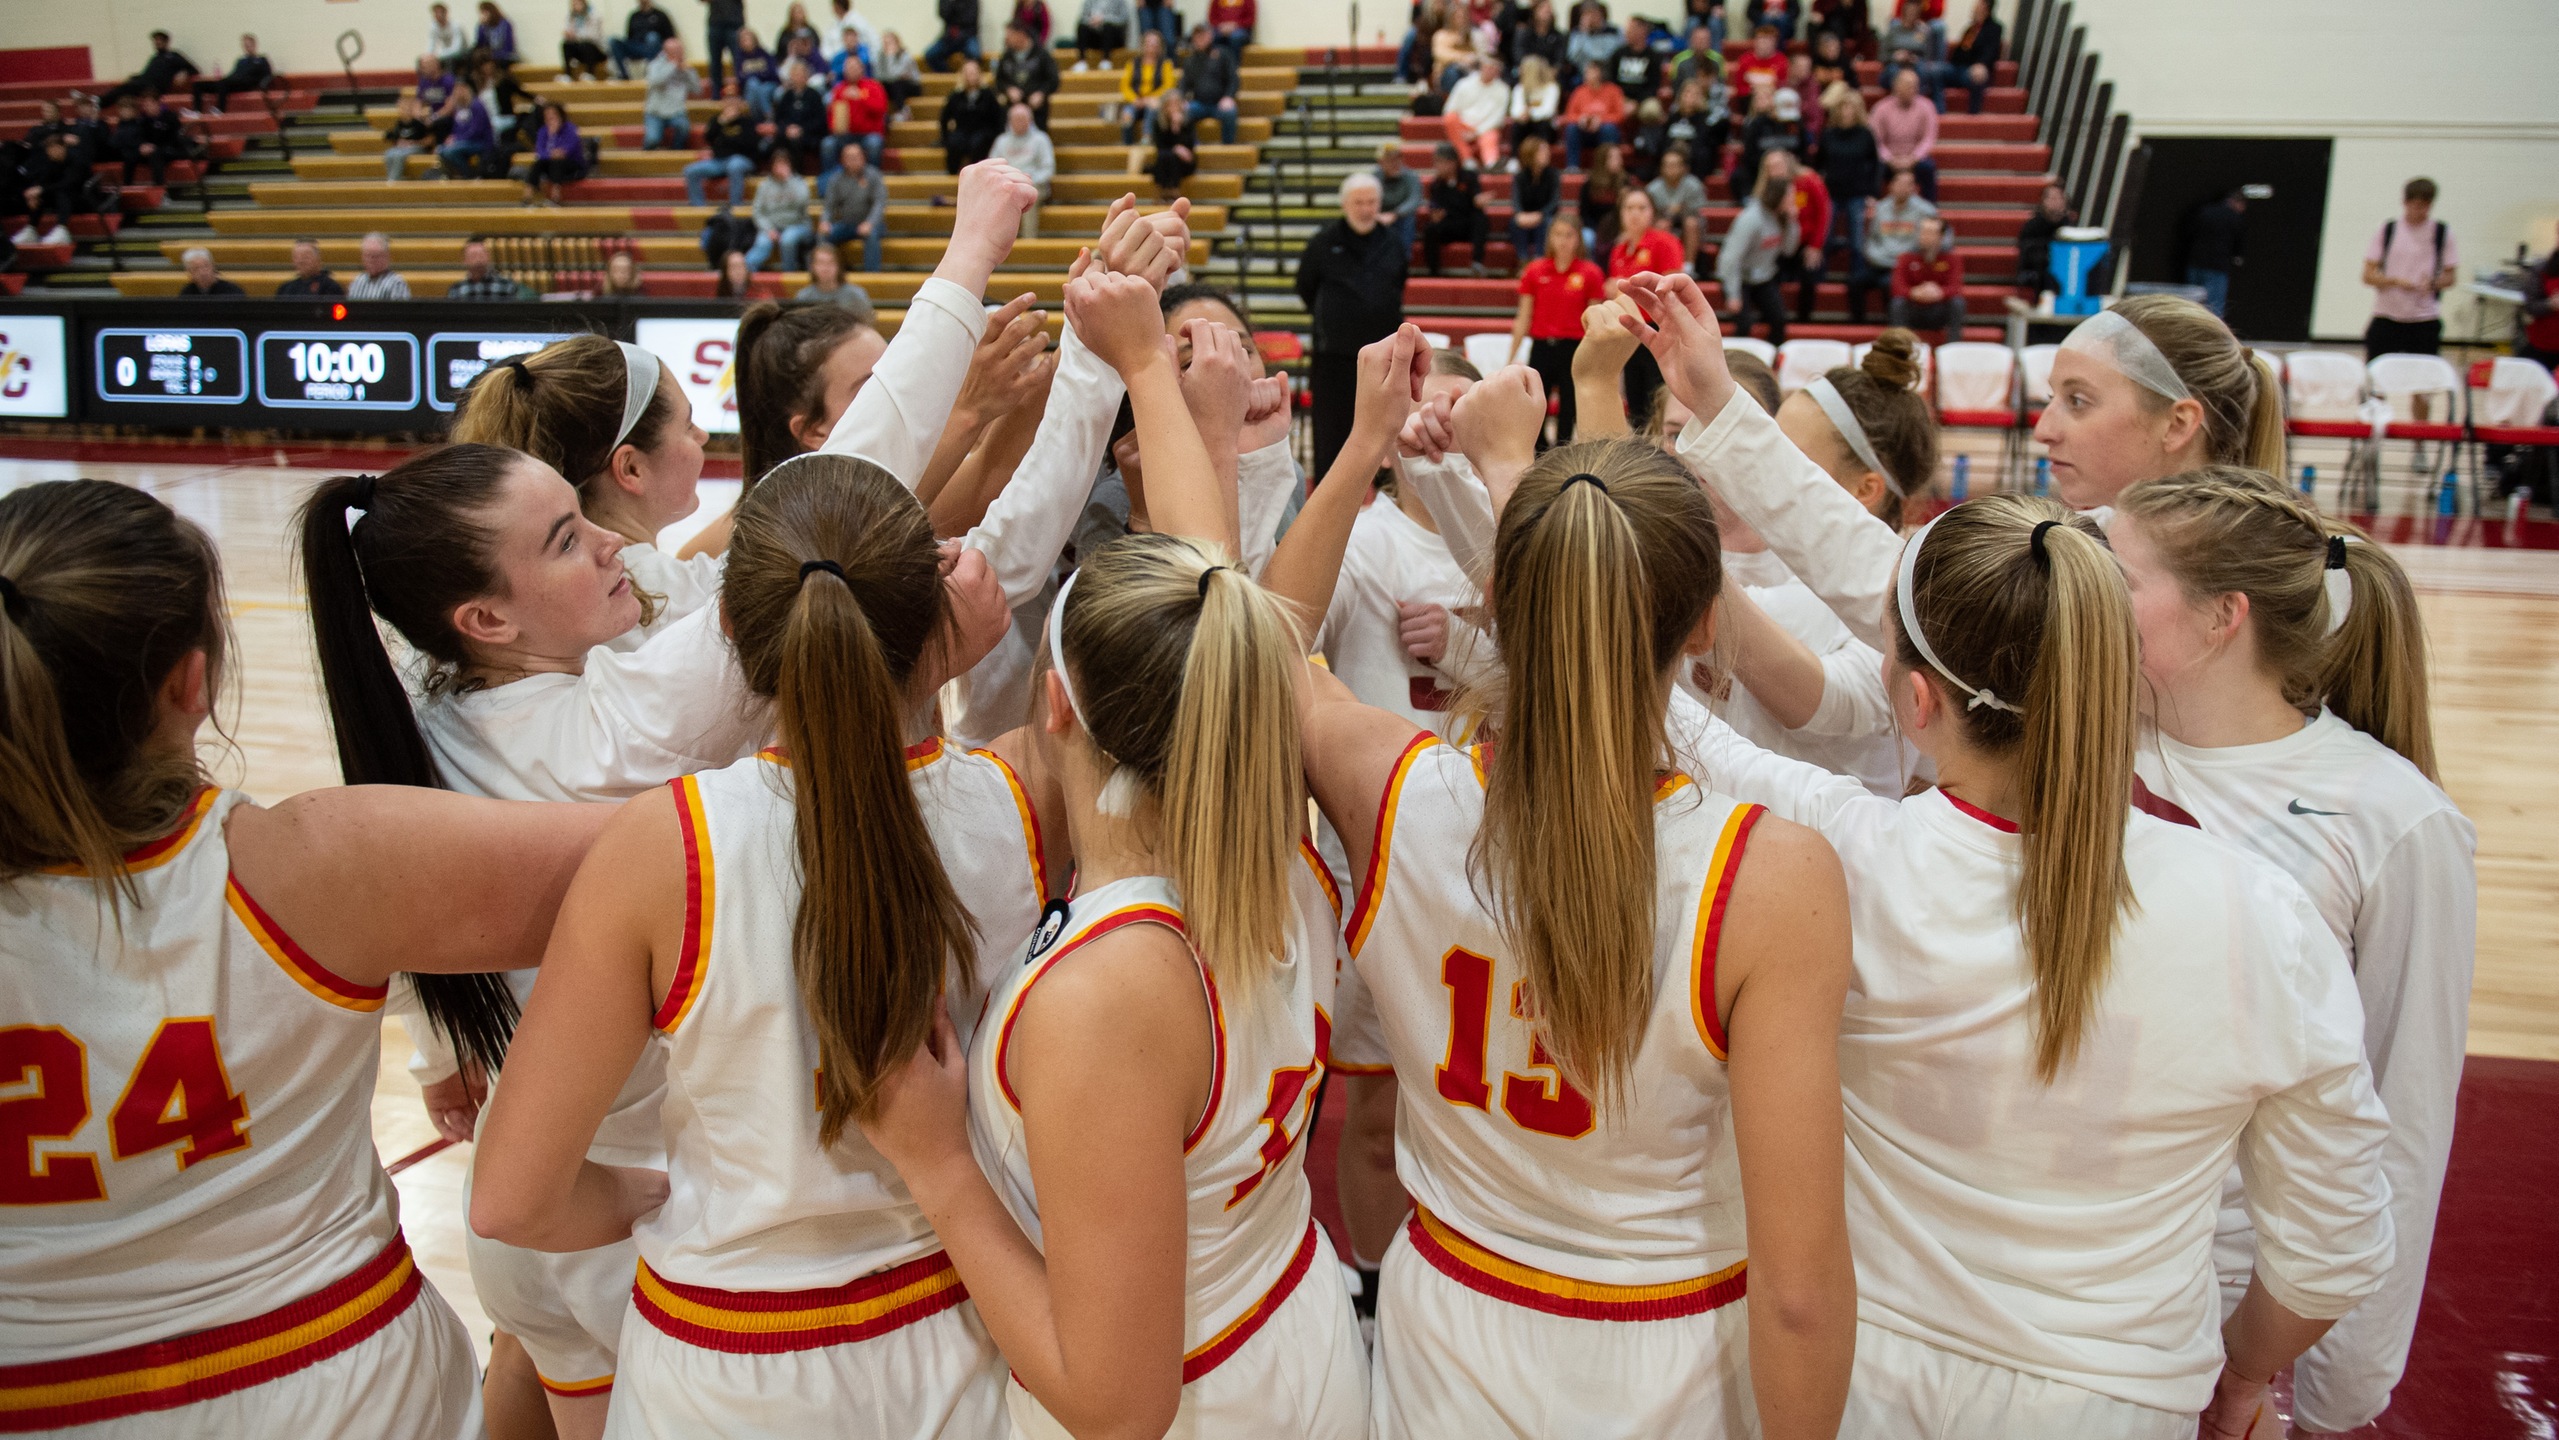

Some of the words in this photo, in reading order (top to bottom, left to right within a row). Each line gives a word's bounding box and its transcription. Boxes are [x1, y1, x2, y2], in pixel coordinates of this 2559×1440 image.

[116, 356, 137, 387] 0
[288, 342, 386, 383] 10:00
[0, 1015, 252, 1207] 24
